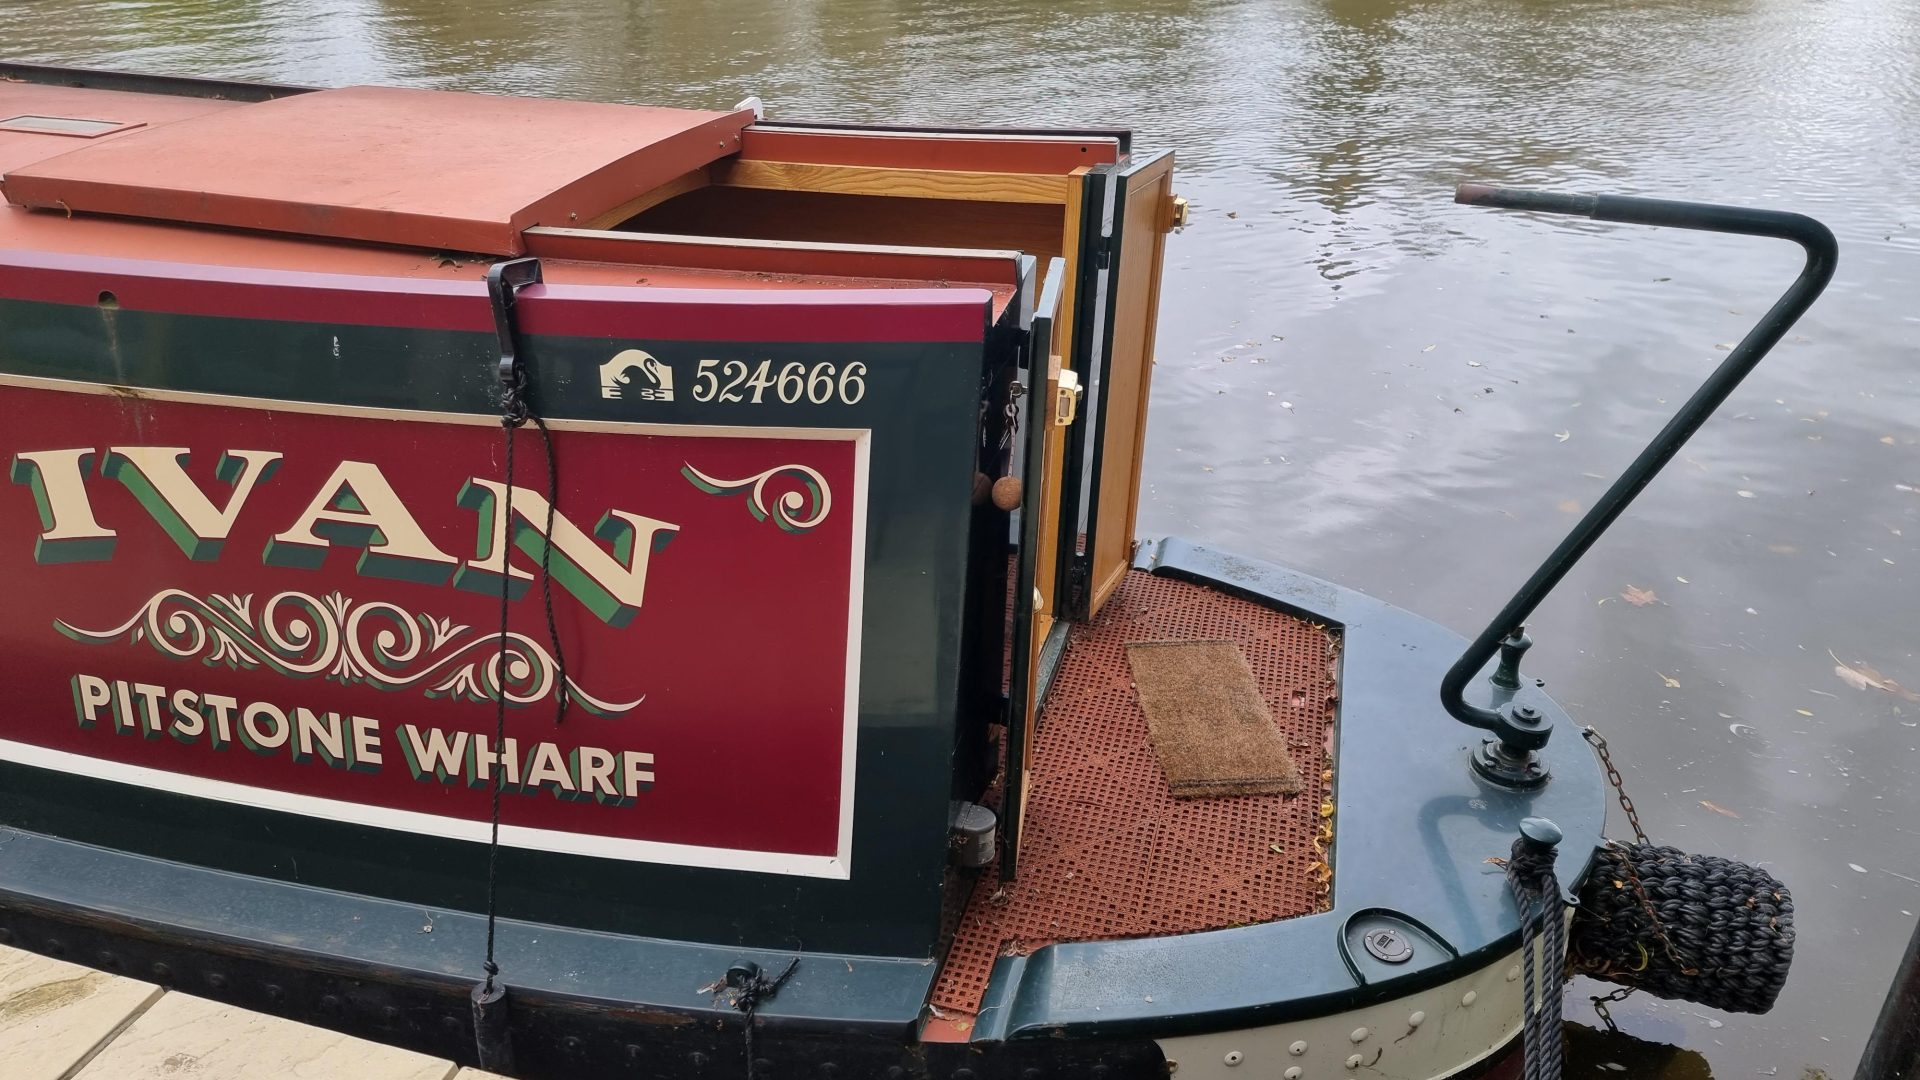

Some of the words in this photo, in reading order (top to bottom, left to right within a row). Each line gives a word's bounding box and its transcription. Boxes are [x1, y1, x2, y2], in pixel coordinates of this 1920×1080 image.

[692, 359, 868, 405] 524666
[13, 446, 681, 617] IVAN
[74, 673, 384, 768] PITSTONE
[399, 723, 656, 803] WHARF
